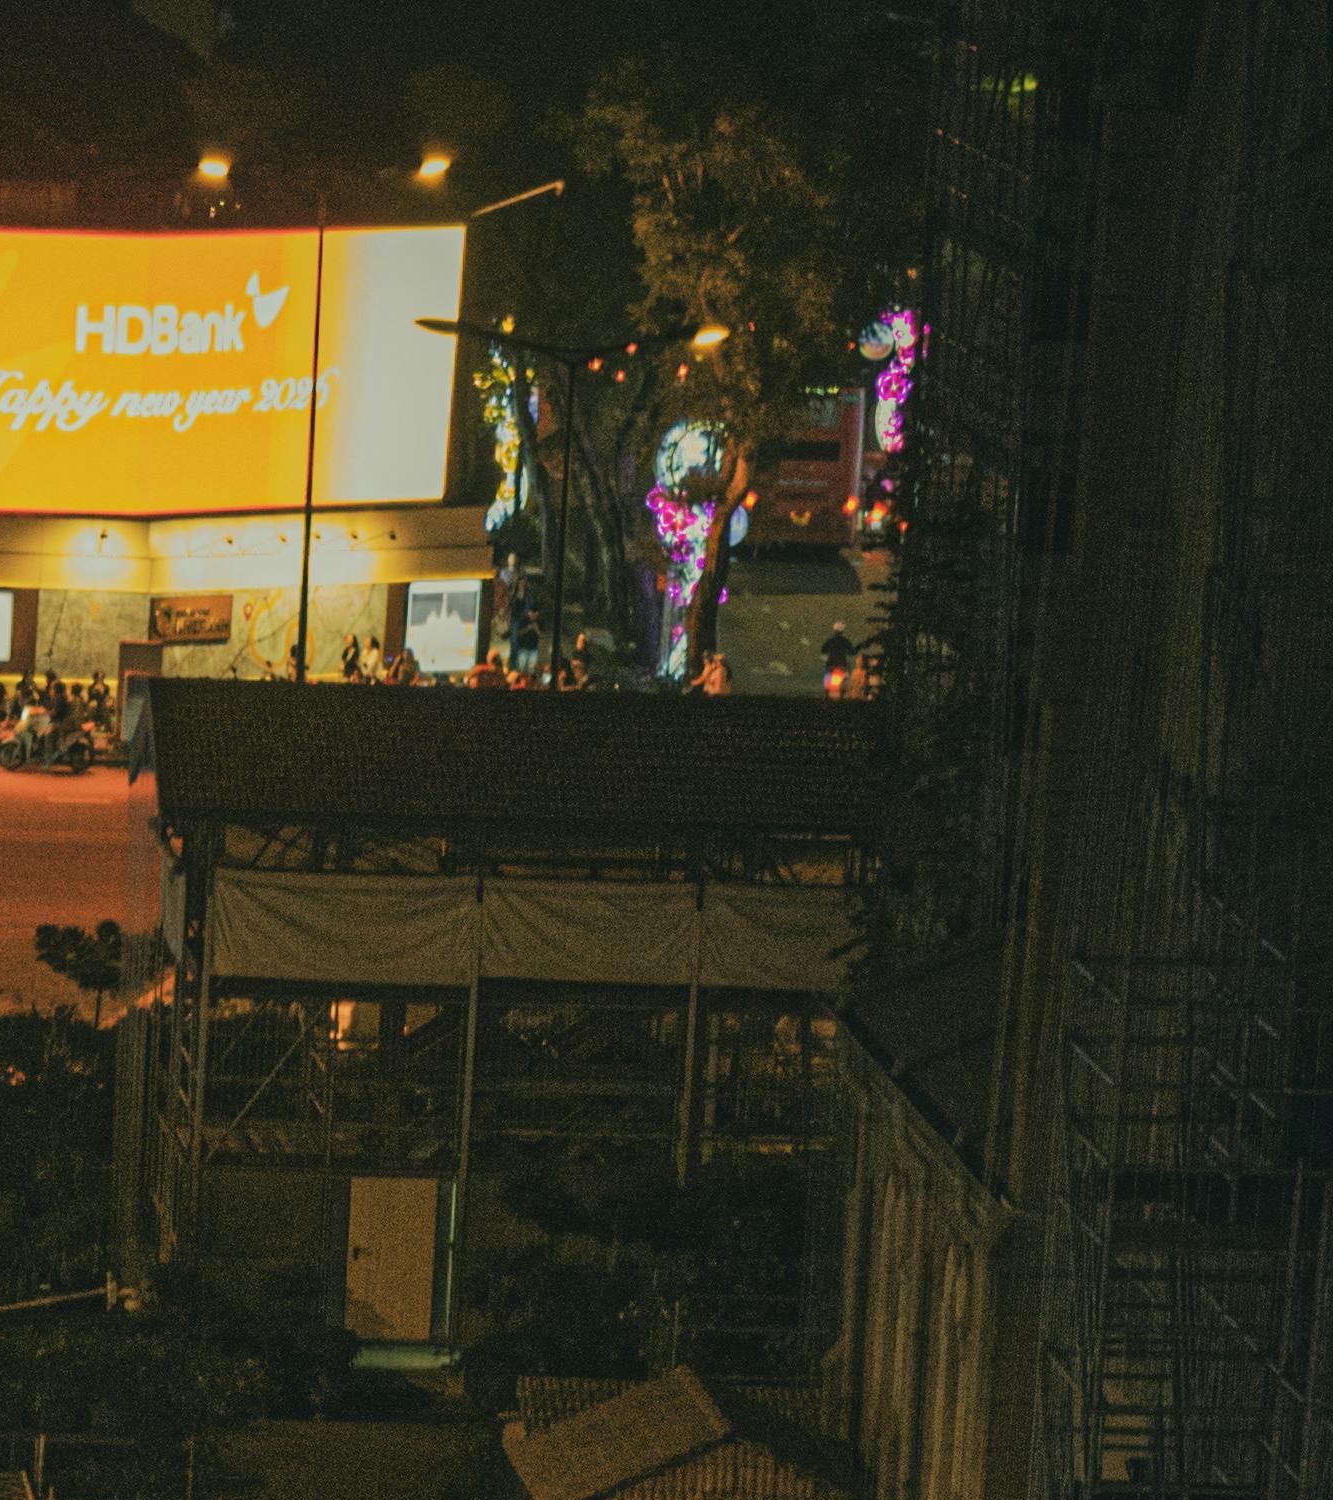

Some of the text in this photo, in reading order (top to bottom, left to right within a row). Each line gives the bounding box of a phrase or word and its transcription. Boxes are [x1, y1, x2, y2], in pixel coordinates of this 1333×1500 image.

[74, 304, 246, 355] HDBank
[110, 387, 181, 418] new
[173, 386, 252, 432] year
